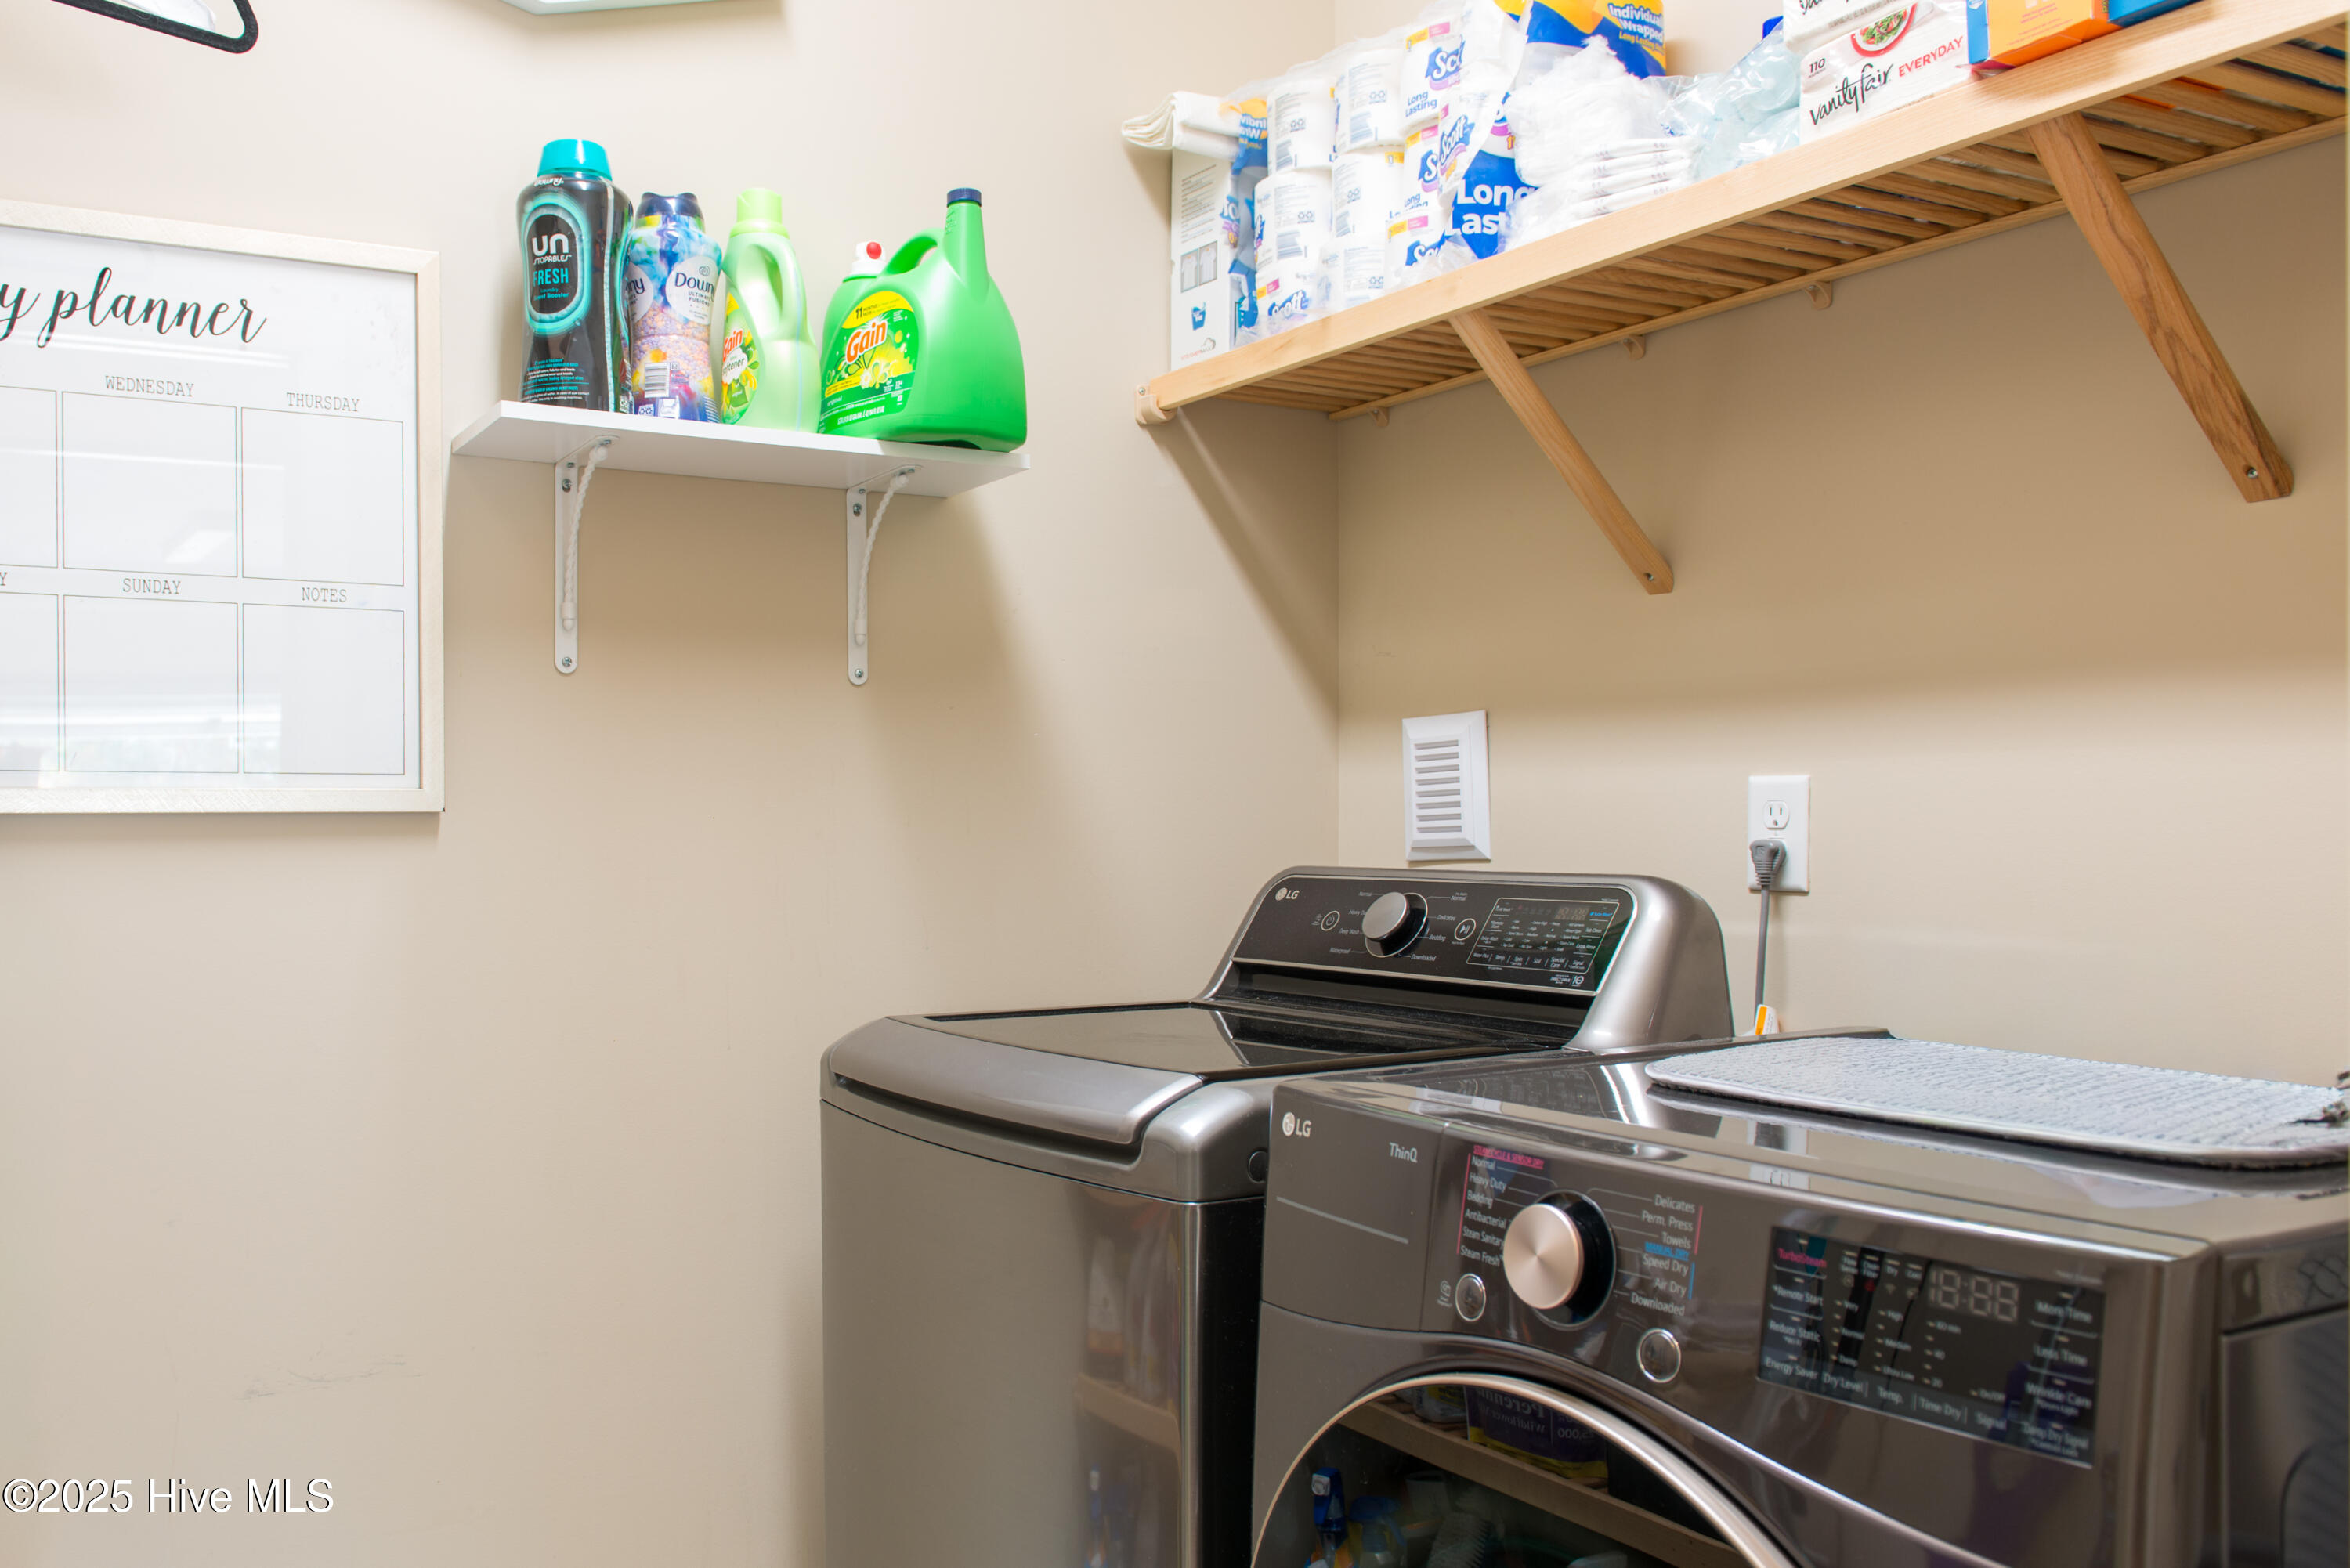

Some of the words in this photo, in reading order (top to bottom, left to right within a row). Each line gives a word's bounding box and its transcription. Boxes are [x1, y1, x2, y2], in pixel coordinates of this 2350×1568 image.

[1810, 58, 1826, 74] 110
[1898, 36, 1962, 77] EVERYDAY
[1405, 99, 1437, 118] Lasting
[1408, 92, 1428, 106] Long
[1441, 115, 1467, 163] Scott
[533, 268, 569, 287] FRESH
[37, 267, 267, 348] planner
[847, 320, 887, 363] Gain
[105, 375, 195, 397] WEDNESDAY
[287, 392, 360, 413] THURSDAY
[122, 577, 182, 595] SUNDAY
[301, 587, 348, 603] NOTES
[1285, 890, 1300, 900] LG
[1296, 1118, 1311, 1137] LG
[1389, 1142, 1418, 1163] ThinQ
[1471, 1154, 1496, 1170] Normal
[1469, 1172, 1488, 1189] Heavy
[1490, 1176, 1507, 1194] Duty
[1466, 1190, 1493, 1209] Bedding
[1654, 1194, 1695, 1213] Delicates
[1465, 1209, 1506, 1229] Antibacterial
[1642, 1210, 1666, 1227] Perm.
[1668, 1216, 1693, 1232] Press
[1462, 1226, 1480, 1241] Steam
[1661, 1231, 1691, 1250] Towels
[1460, 1245, 1480, 1260] Steam
[1777, 1248, 1828, 1268] TurboSteam
[1642, 1253, 1670, 1270] Speed
[1671, 1259, 1689, 1277] Dry
[1885, 1265, 1899, 1277] Dry
[1654, 1277, 1668, 1292] Air
[1668, 1281, 1687, 1298] Dry
[1630, 1292, 1685, 1317] Downloaded
[1805, 1292, 1824, 1307] Start
[1843, 1300, 1859, 1313] Very
[2066, 1305, 2093, 1324] Time
[1768, 1320, 1797, 1336] Reduce
[1797, 1326, 1821, 1342] Static
[1841, 1328, 1865, 1341] Normal
[2060, 1348, 2088, 1367] Time
[1765, 1355, 1794, 1375] Energy
[1794, 1365, 1818, 1380] Saver
[1822, 1372, 1838, 1389] Dry
[1839, 1377, 1863, 1393] Level
[2066, 1391, 2092, 1409] Care
[1919, 1396, 1943, 1414] Time
[1943, 1401, 1962, 1420] Dry
[1975, 1411, 2007, 1431] Signal
